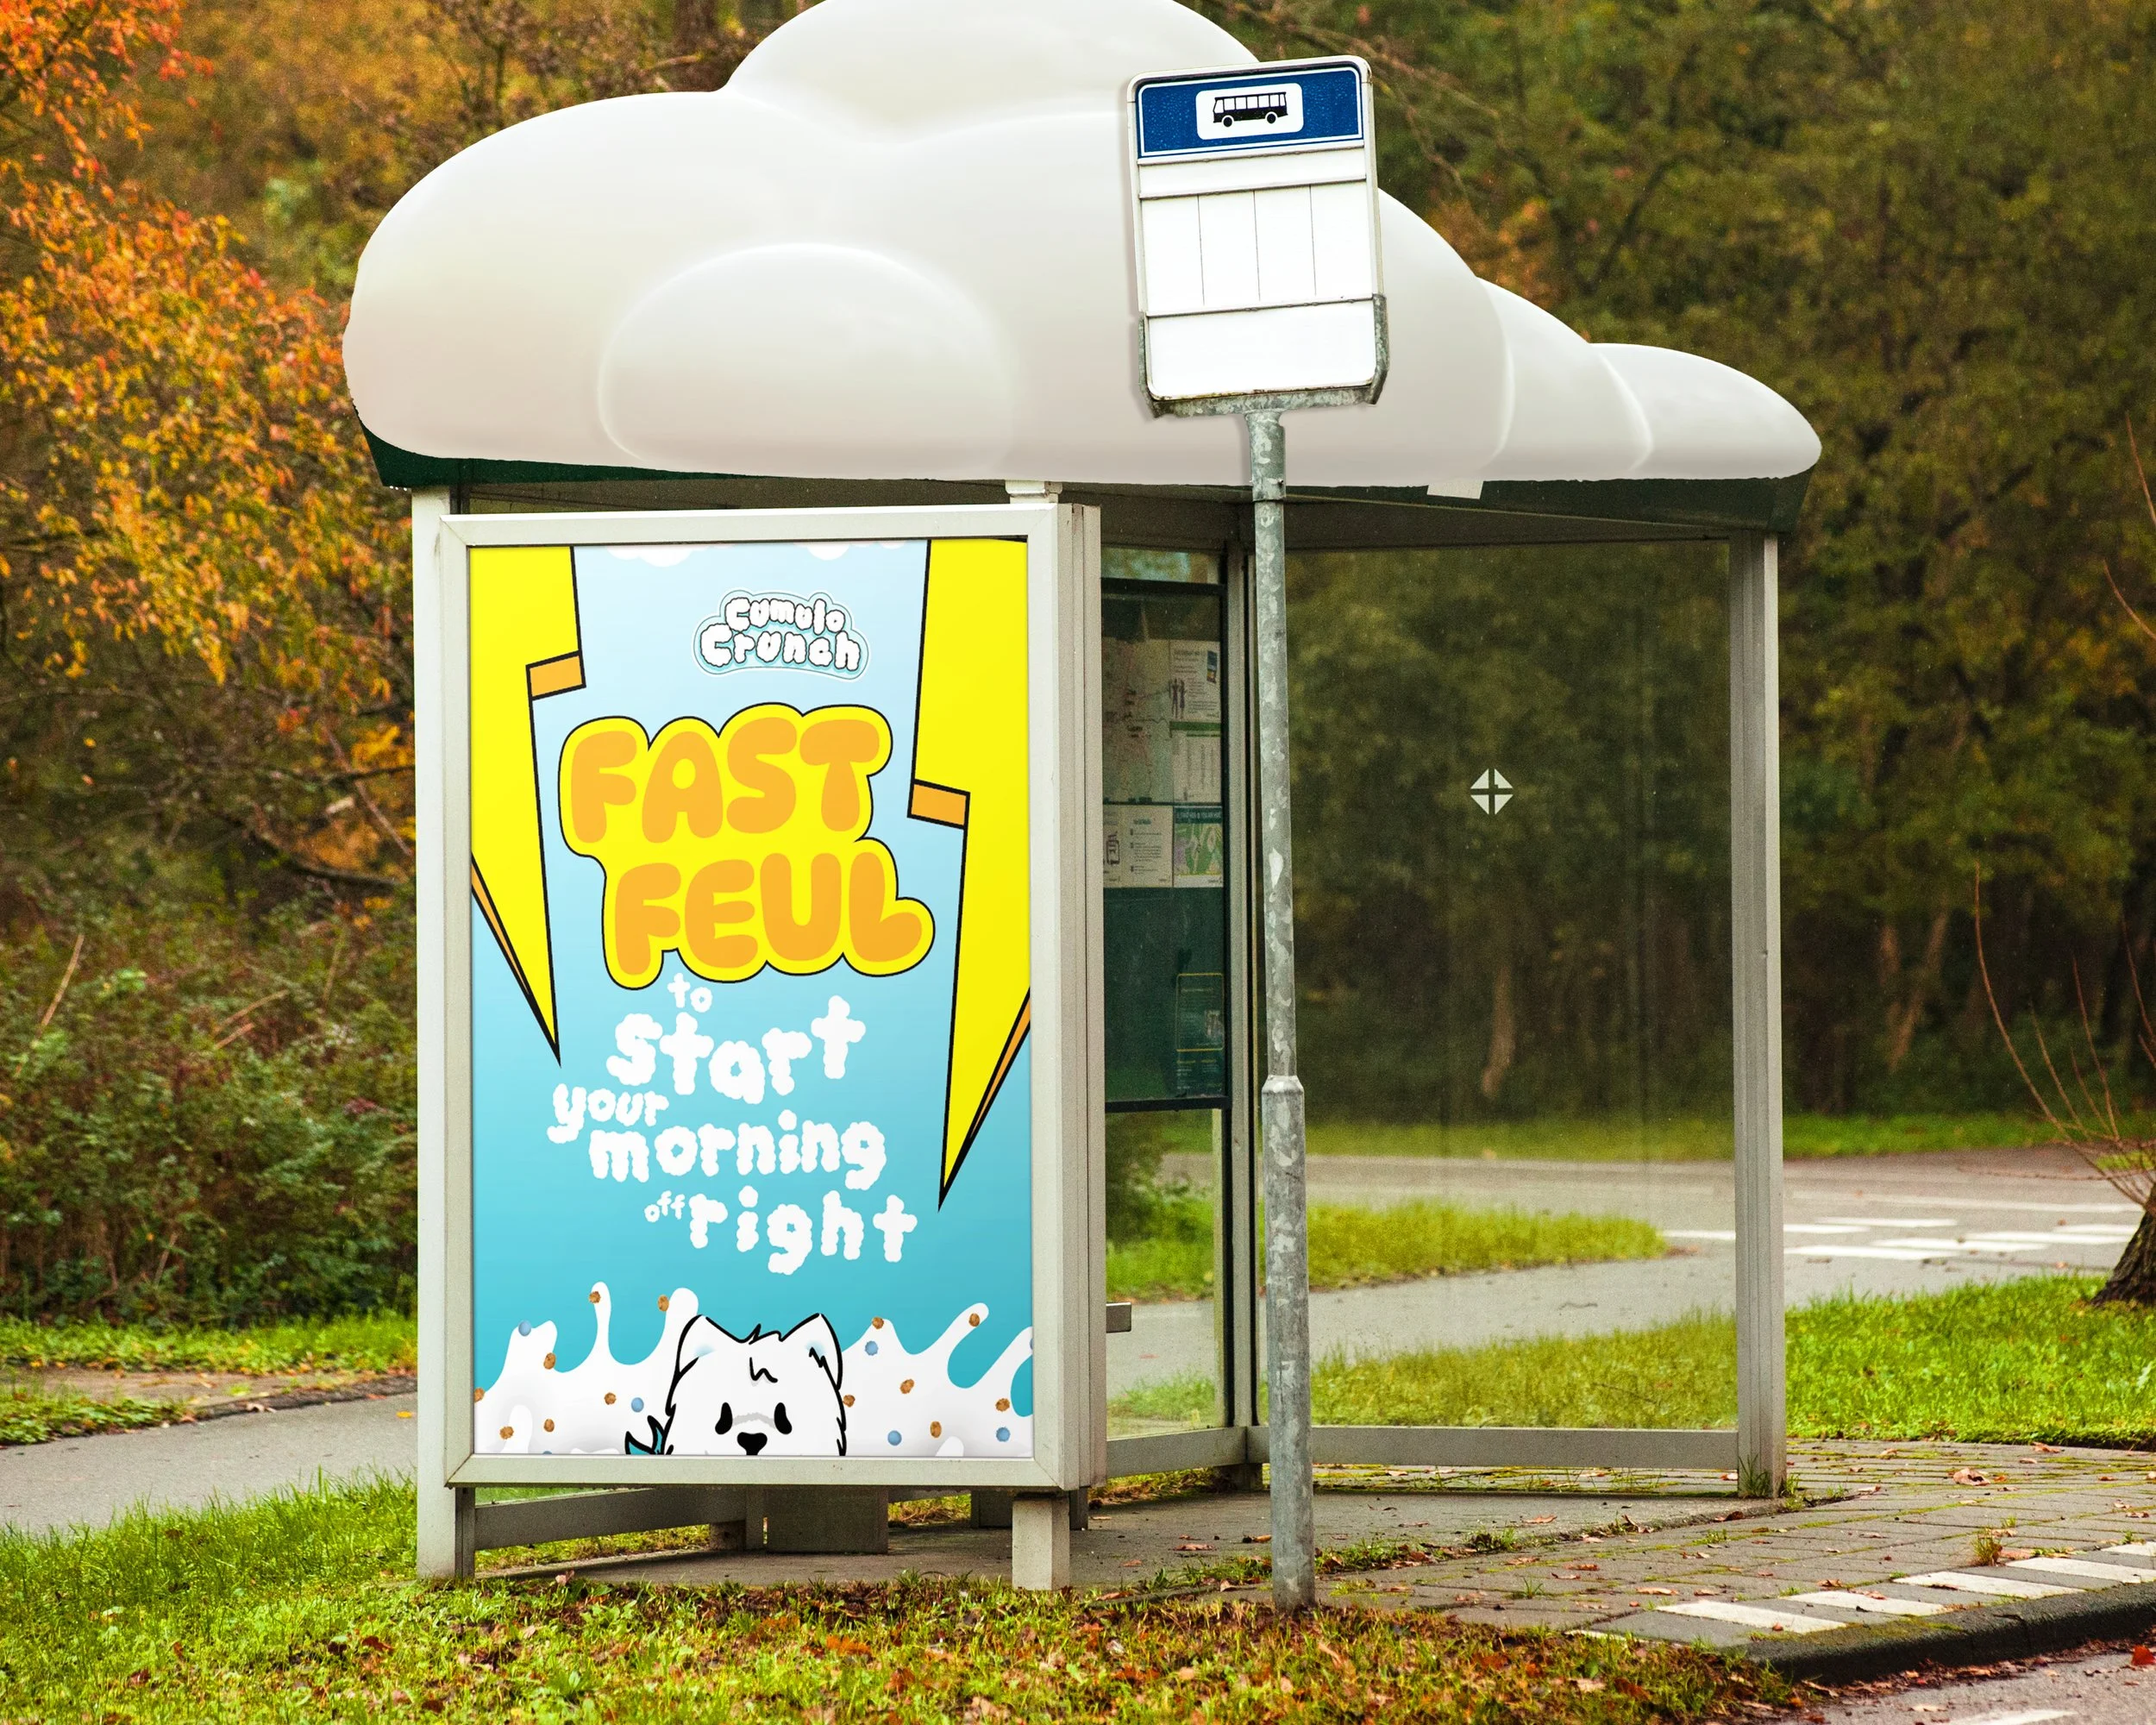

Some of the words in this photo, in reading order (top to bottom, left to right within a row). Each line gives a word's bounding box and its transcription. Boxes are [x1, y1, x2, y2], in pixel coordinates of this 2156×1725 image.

[700, 623, 862, 672] Crunch
[725, 597, 845, 636] Cumulo
[571, 717, 881, 844] FAST
[615, 852, 923, 976] FEUL
[667, 973, 712, 1013] to
[606, 995, 866, 1104] start
[548, 1084, 669, 1144] your
[589, 1110, 887, 1190] morning
[645, 1190, 685, 1222] off
[689, 1185, 918, 1275] right
